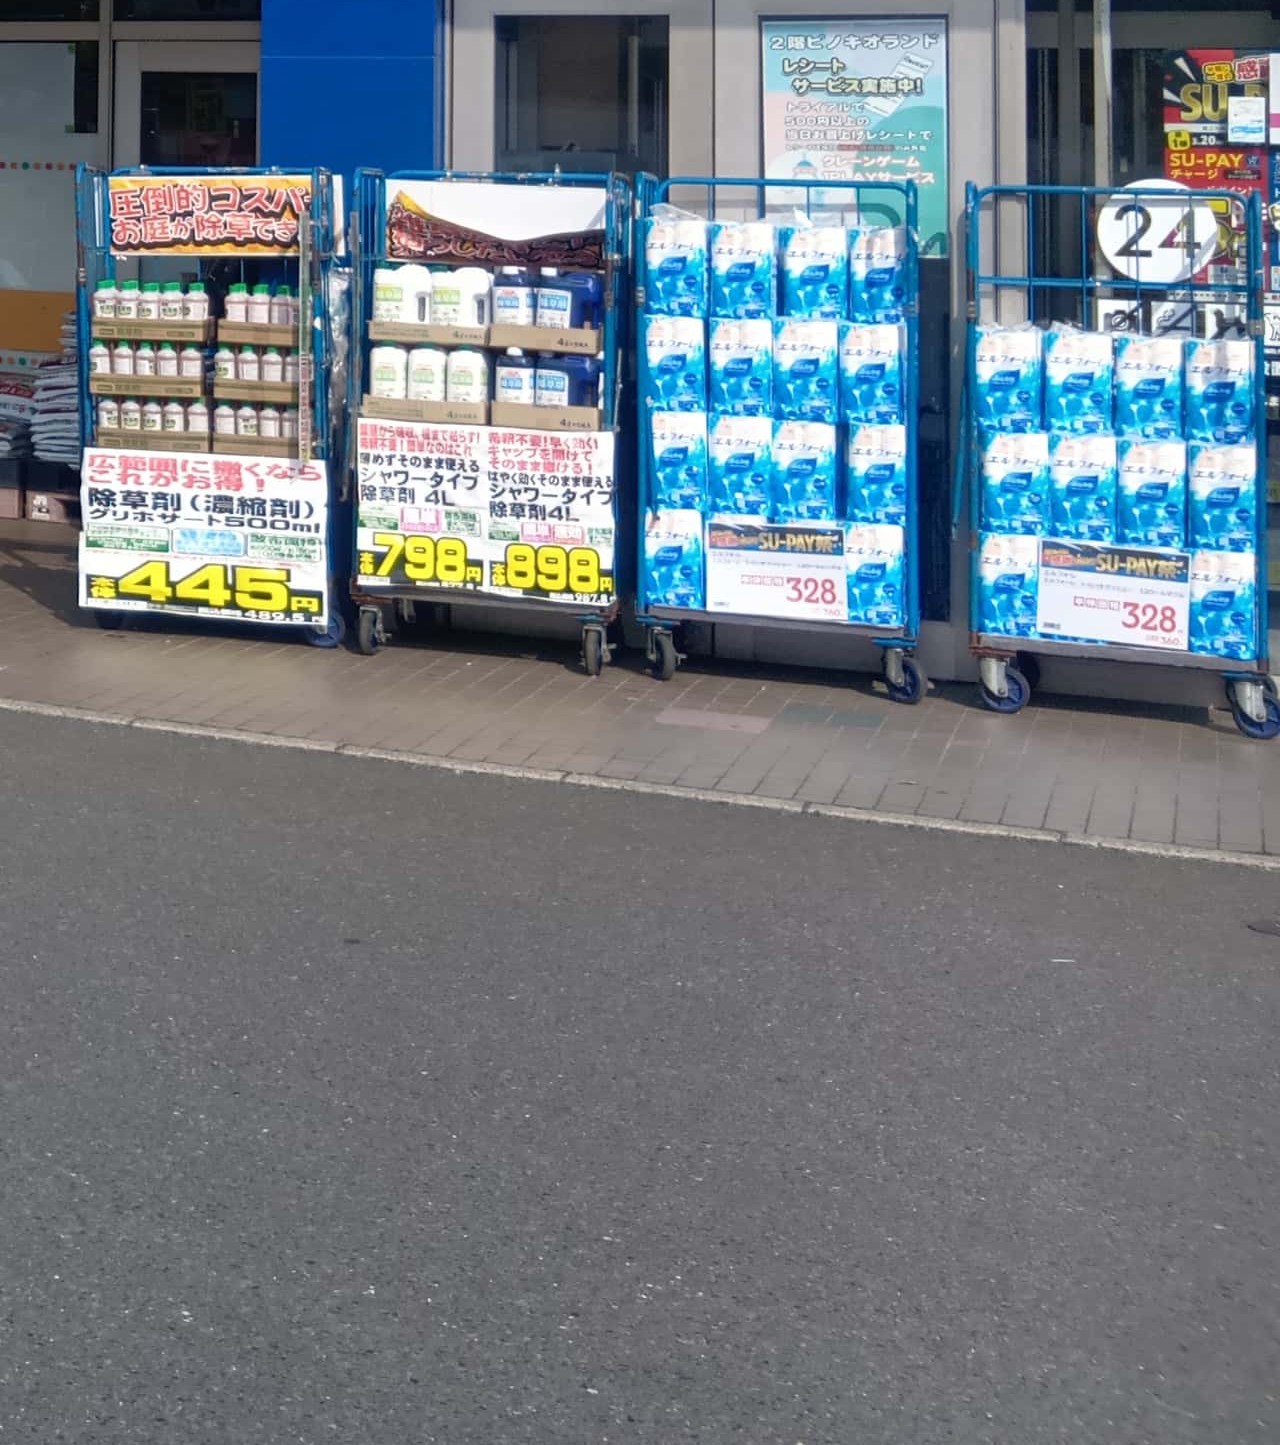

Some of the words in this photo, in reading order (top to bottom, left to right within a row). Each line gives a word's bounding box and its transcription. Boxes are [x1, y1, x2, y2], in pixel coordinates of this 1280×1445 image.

[783, 57, 845, 74] レシート
[1170, 154, 1242, 167] SU-PAY
[1114, 204, 1202, 258] 24
[360, 467, 479, 490] シャワータイプ
[489, 483, 613, 506] シャワータイプ
[786, 577, 837, 605] 328
[1122, 601, 1176, 633] 328
